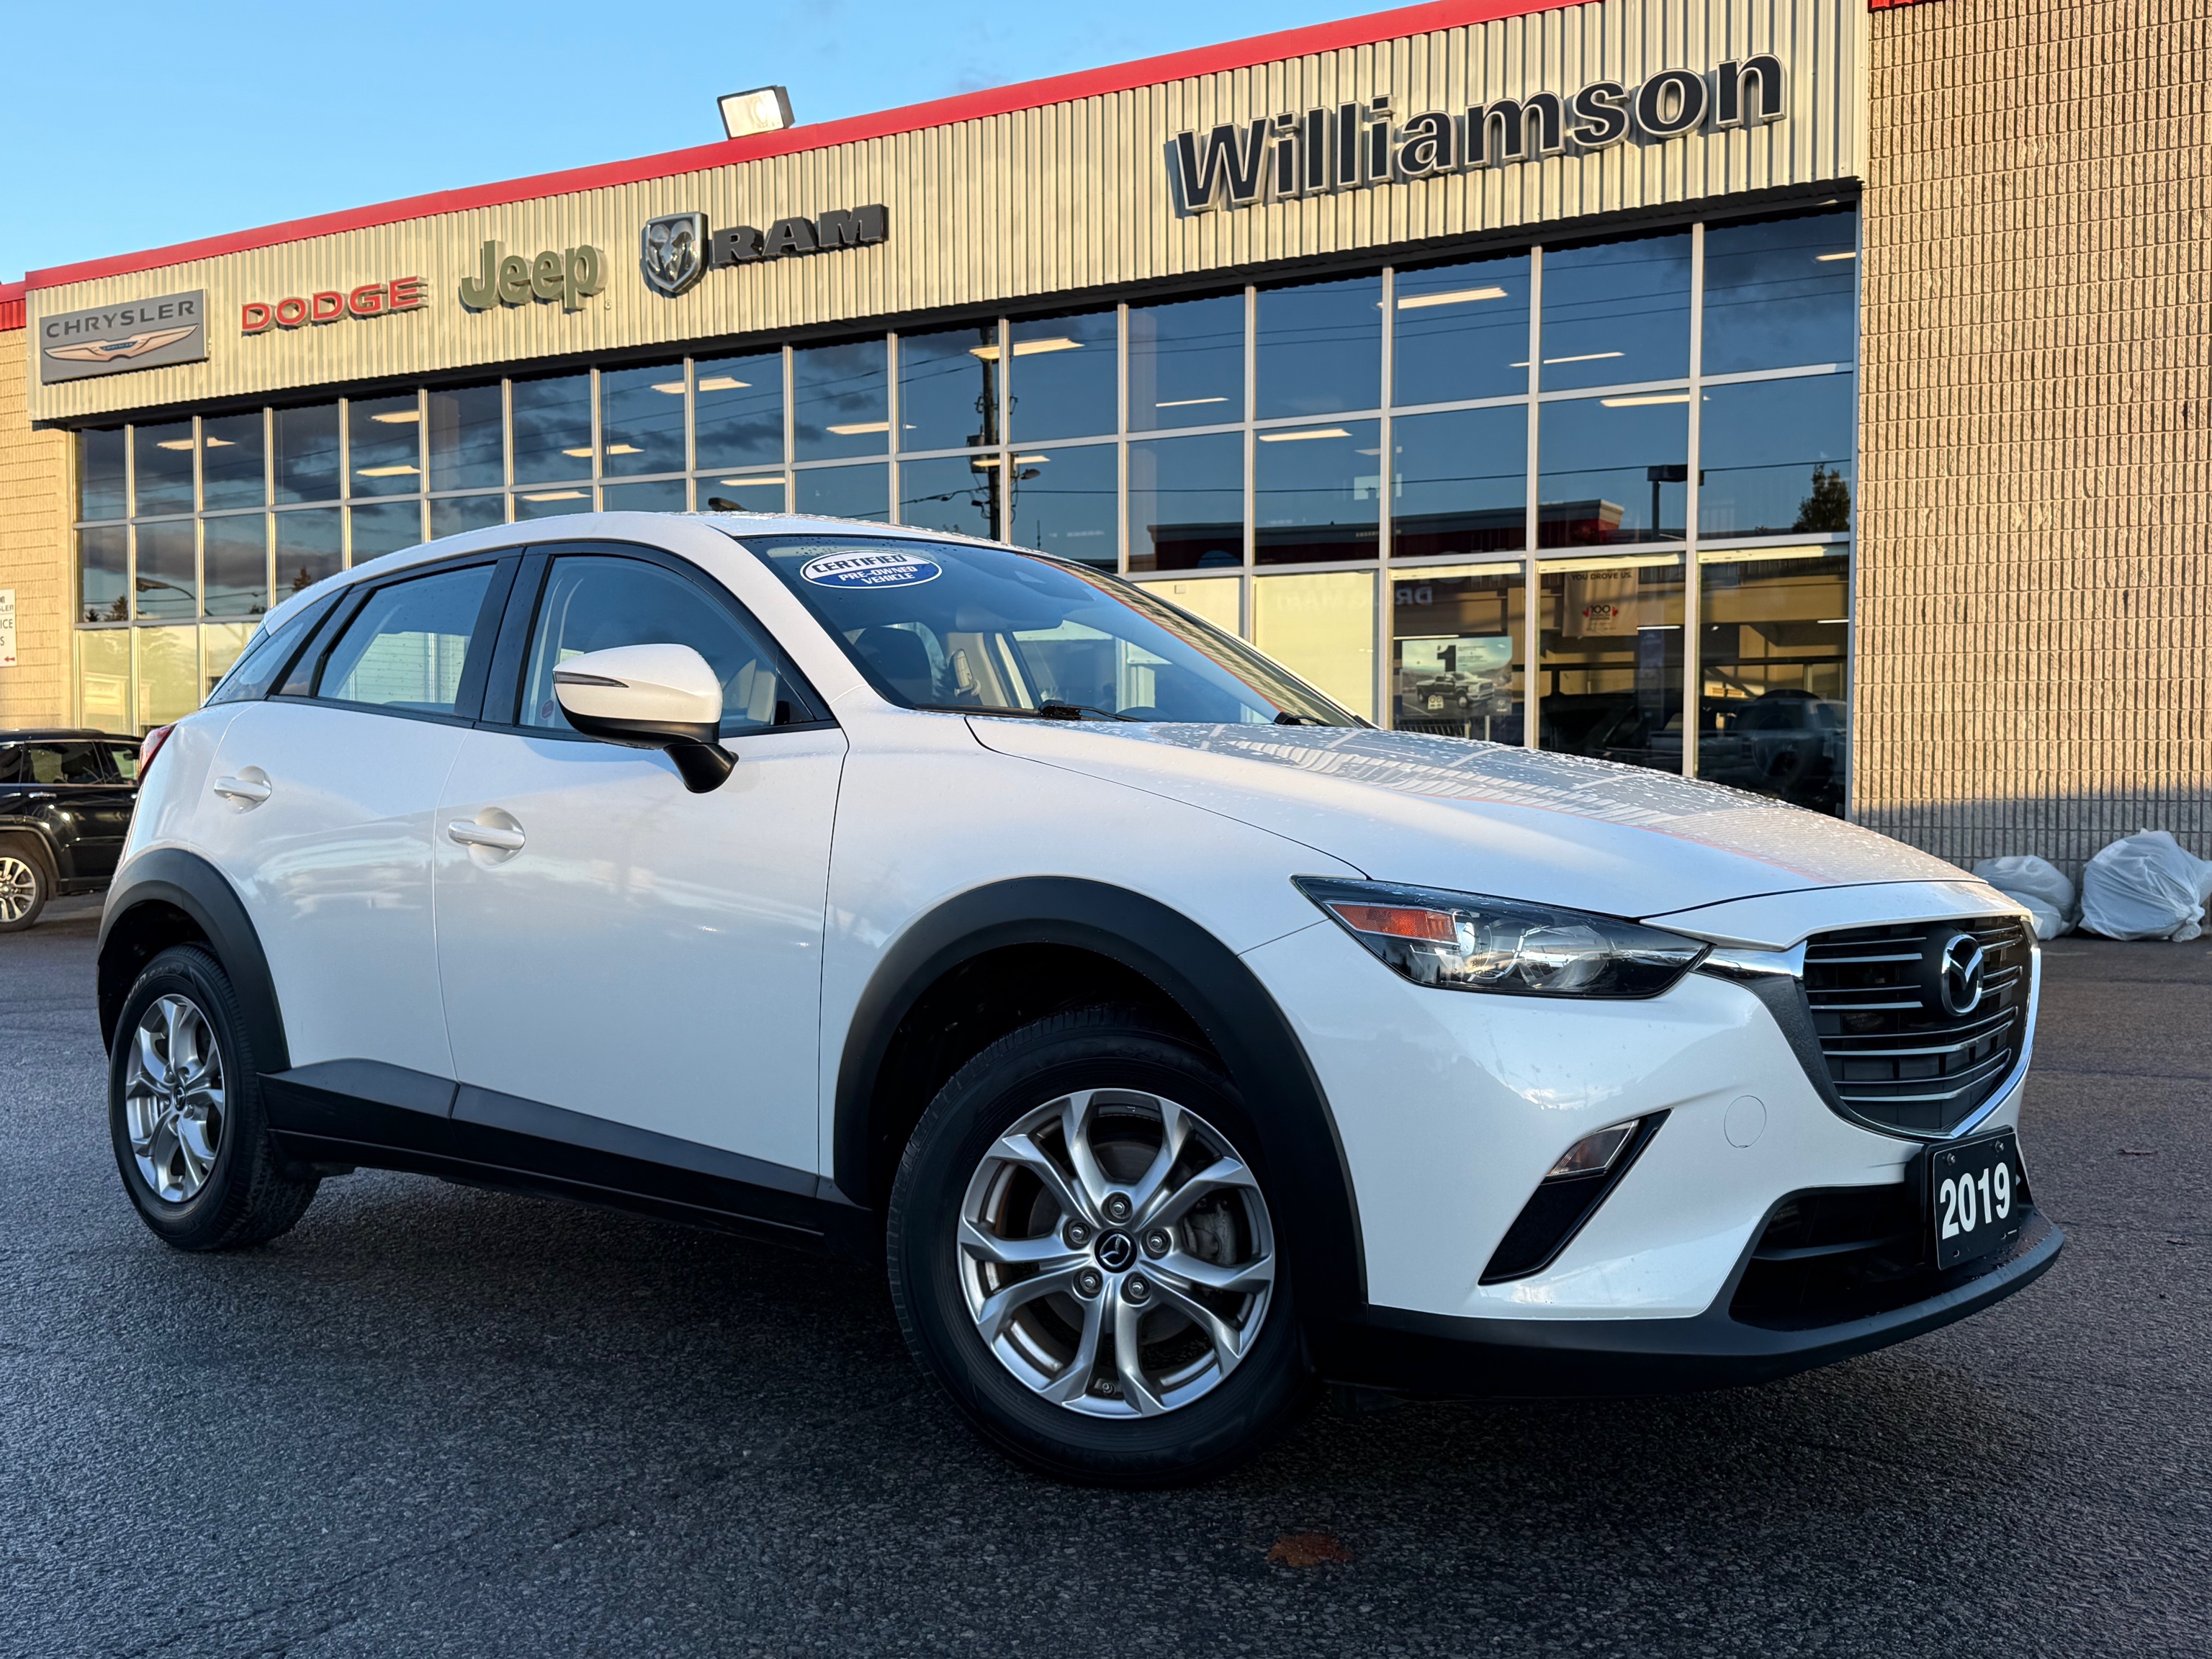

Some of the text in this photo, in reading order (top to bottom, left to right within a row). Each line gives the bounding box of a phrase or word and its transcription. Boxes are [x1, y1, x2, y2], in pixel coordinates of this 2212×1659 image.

[1173, 53, 1788, 215] Williamson
[711, 203, 889, 270] RAM
[459, 239, 608, 313] Jeep
[46, 300, 195, 338] CHRYSLER
[240, 276, 428, 337] DODGE
[811, 554, 908, 573] CERTIFIED
[838, 565, 918, 581] PRE-OWNED
[861, 572, 915, 585] VEHICLE
[1590, 572, 1619, 580] DROVE
[1590, 604, 1611, 613] 100
[1939, 1162, 2010, 1240] 2019
